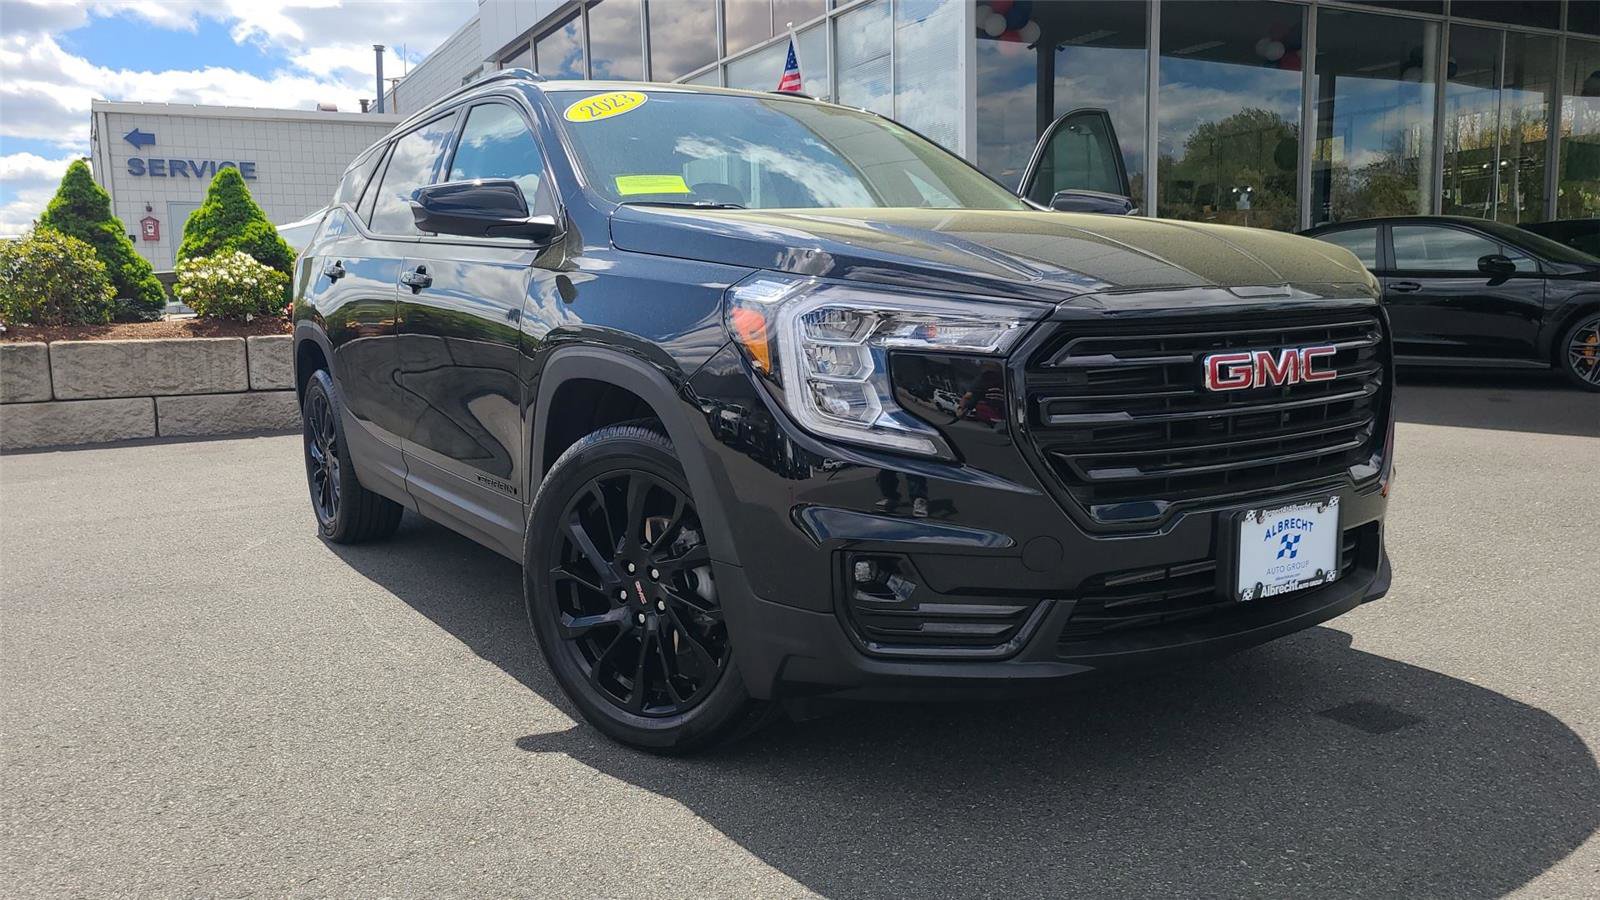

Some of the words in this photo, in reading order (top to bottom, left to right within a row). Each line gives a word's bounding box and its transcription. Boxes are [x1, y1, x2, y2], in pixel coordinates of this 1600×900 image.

[580, 93, 635, 117] 2023
[1204, 345, 1337, 391] GMC
[1263, 518, 1314, 541] ALBRECHT
[1266, 564, 1285, 576] AUTO
[1286, 560, 1310, 573] GROUP
[1260, 579, 1299, 598] Albrecht
